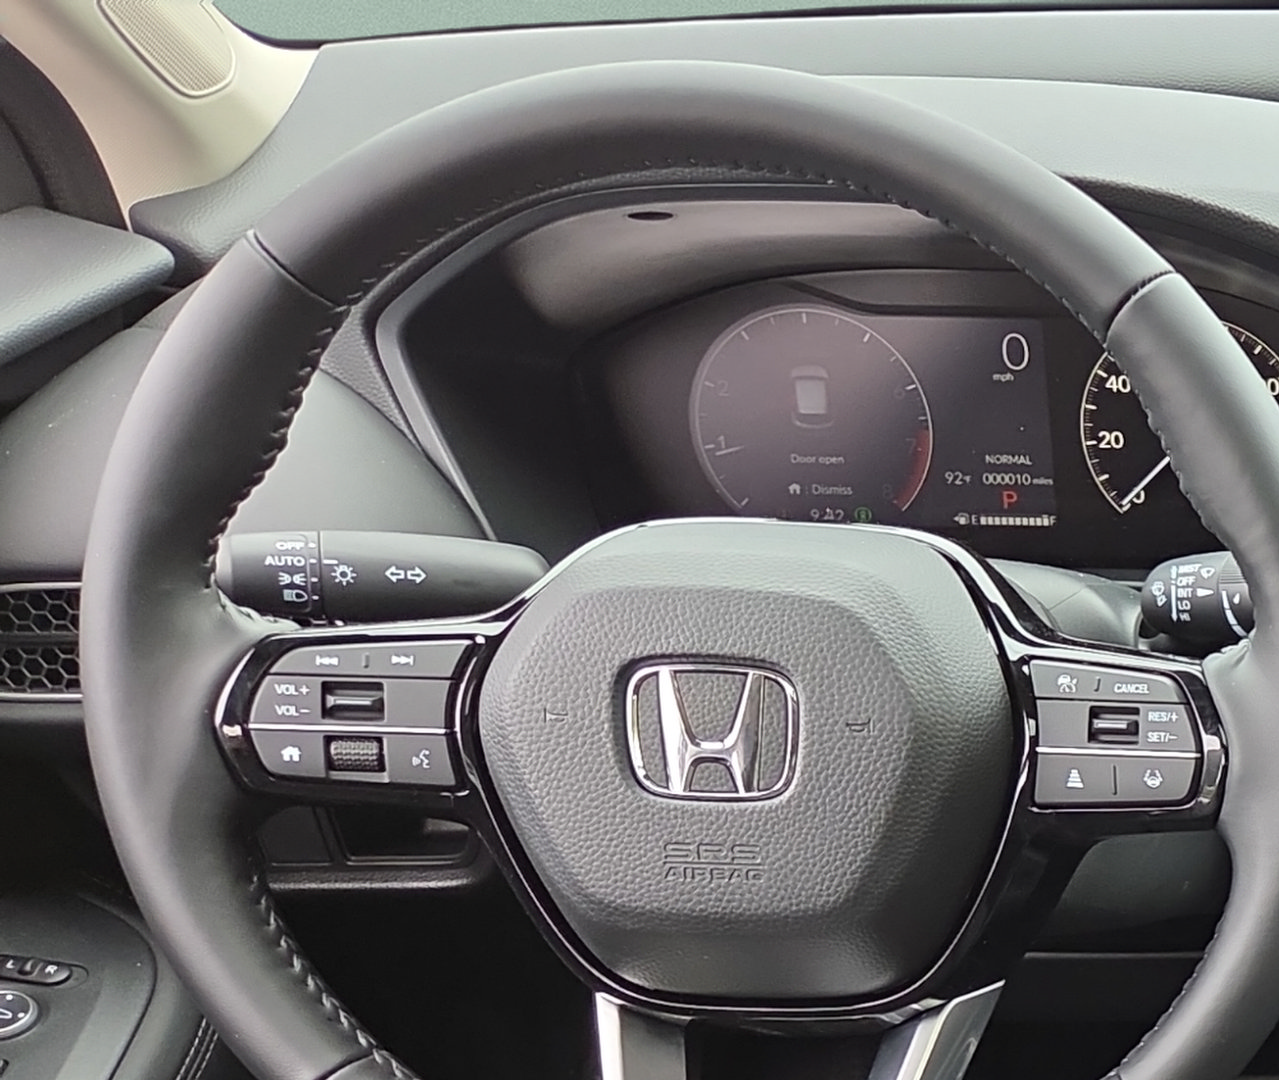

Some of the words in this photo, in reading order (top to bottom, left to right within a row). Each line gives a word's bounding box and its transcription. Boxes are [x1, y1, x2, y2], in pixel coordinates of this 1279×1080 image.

[1002, 333, 1029, 370] 0
[992, 373, 1014, 382] mph
[716, 380, 729, 397] 2
[1105, 375, 1130, 393] 40
[717, 435, 726, 449] 1
[1098, 431, 1125, 449] 20
[791, 453, 816, 464] Door
[818, 456, 845, 465] open
[985, 454, 1033, 465] NORMAL
[982, 472, 1031, 485] 000010
[811, 484, 853, 495] Dismiss
[1003, 490, 1018, 509] P
[971, 514, 979, 525] E
[1050, 515, 1057, 526] F
[275, 541, 305, 550] OFF
[264, 555, 306, 566] AUTO
[1177, 576, 1197, 586] OFF
[1177, 588, 1193, 598] INT
[1178, 600, 1191, 611] LO
[1114, 683, 1150, 694] CANCEL
[663, 842, 761, 862] SRS
[664, 867, 764, 881] AIRBAG
[6, 959, 16, 969] L
[44, 964, 59, 975] R
